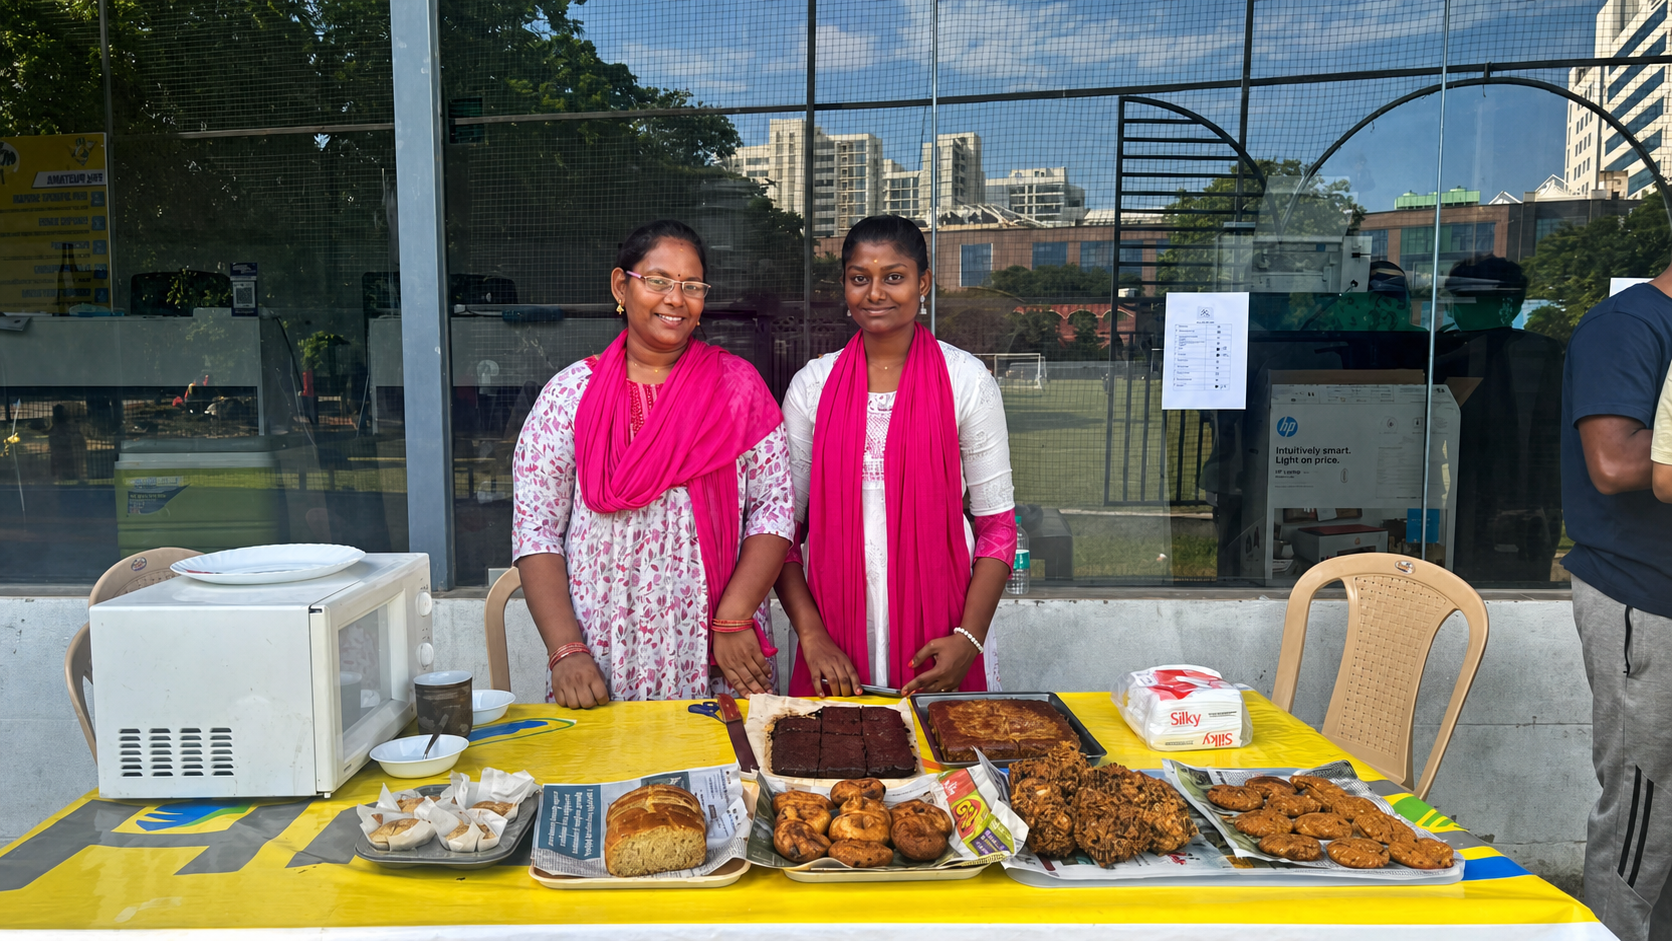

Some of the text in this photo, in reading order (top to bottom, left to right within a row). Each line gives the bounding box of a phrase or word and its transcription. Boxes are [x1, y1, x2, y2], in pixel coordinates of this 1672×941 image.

[1278, 416, 1297, 437] hp
[1276, 446, 1351, 456] Intuitively smart.
[1275, 456, 1299, 466] Light
[1314, 456, 1340, 465] price.
[1170, 712, 1201, 727] Silky
[1202, 733, 1232, 746] Silky
